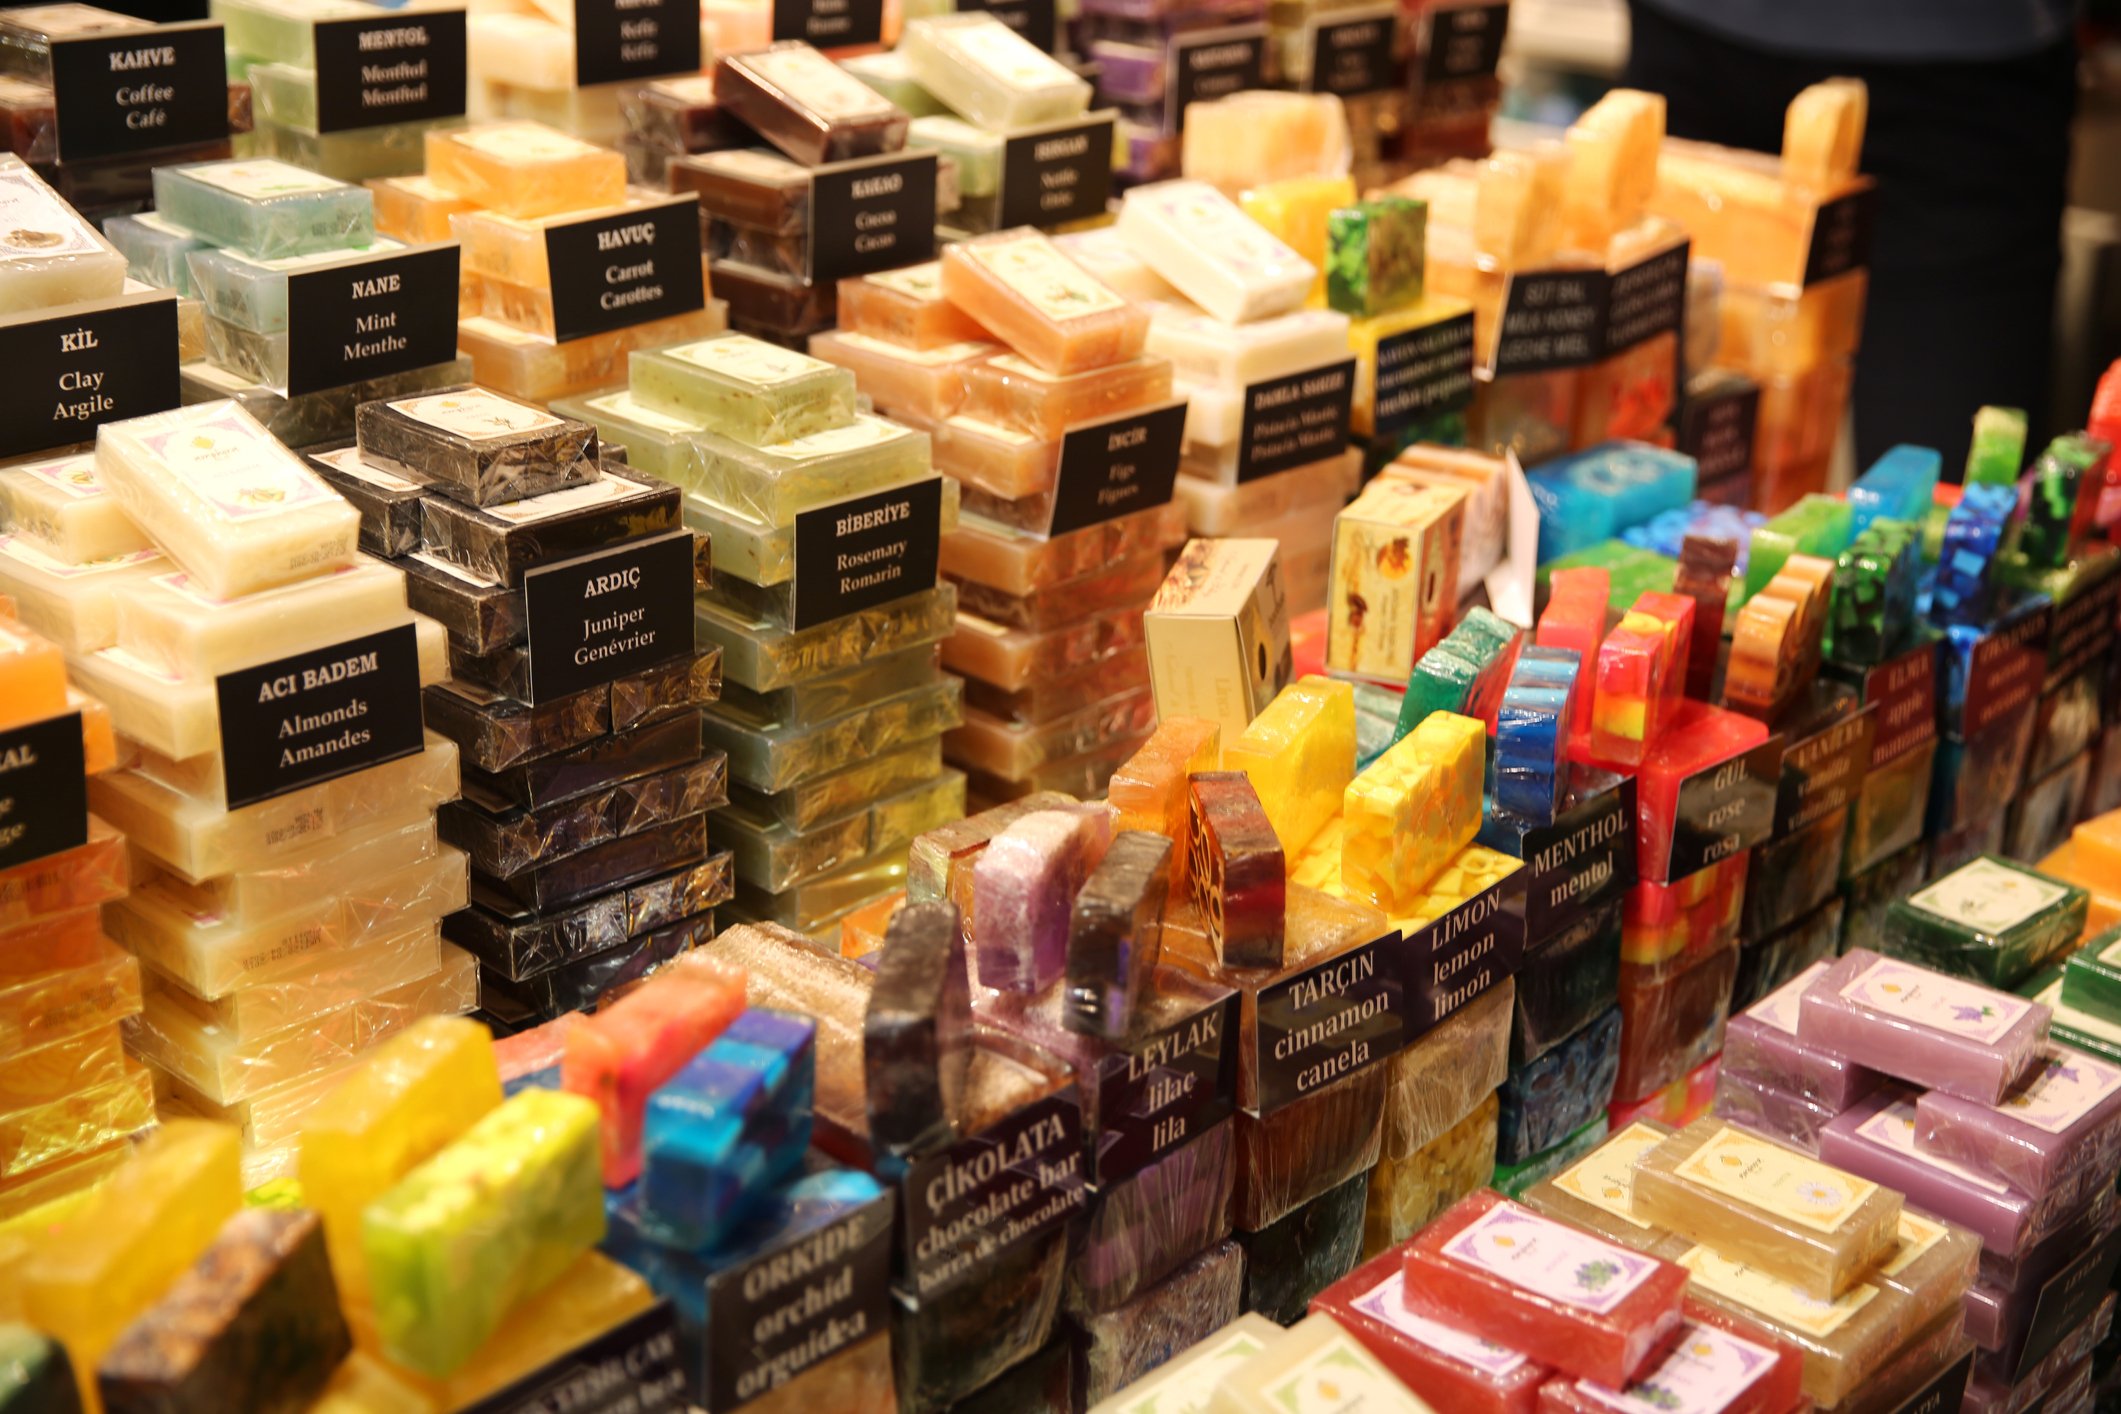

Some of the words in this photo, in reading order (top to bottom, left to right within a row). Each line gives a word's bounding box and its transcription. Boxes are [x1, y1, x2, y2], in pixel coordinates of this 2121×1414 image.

[358, 26, 430, 51] MENTOL
[109, 46, 176, 72] KAHVE
[361, 59, 428, 83] Menthol
[115, 83, 175, 106] Coffee
[361, 82, 428, 108] Menthol
[126, 107, 167, 130] Café
[598, 222, 656, 250] HAVUÇ
[352, 274, 401, 299] NANE
[605, 259, 654, 284] Carrot
[600, 284, 663, 310] Carottes
[61, 328, 99, 352] KİL
[356, 312, 397, 334] Mint
[344, 335, 407, 361] Menthe
[59, 371, 104, 391] Clay
[53, 395, 114, 420] Argile
[836, 502, 910, 537] BİBERİYE
[837, 540, 908, 571] Rosemary
[584, 566, 641, 598] ARDIÇ
[840, 564, 902, 594] Romarin
[583, 607, 645, 641] Juniper
[574, 630, 656, 666] Genévrier
[258, 674, 297, 703] ACI
[302, 651, 379, 690] BADEM
[278, 699, 368, 739] Almonds
[279, 728, 371, 768] Amandes
[1708, 797, 1745, 829] rose
[1535, 808, 1628, 879] MENTHOL
[1703, 832, 1740, 865] rosa
[1551, 849, 1613, 908] mentol
[1431, 888, 1500, 952] LİMON
[1433, 931, 1495, 986] lemon
[1288, 950, 1374, 1011] TARÇIN
[1434, 965, 1491, 1021] limón
[1274, 990, 1390, 1060] cinnamon
[1128, 1011, 1217, 1083] LEYLAK
[1296, 1039, 1370, 1092] canela
[1149, 1071, 1195, 1114] lilac
[1152, 1115, 1186, 1152] lila
[925, 1113, 1065, 1217] ÇİKOLATA
[916, 1179, 1034, 1260] chocolate
[1038, 1151, 1081, 1190] bar
[974, 1234, 998, 1260] de
[1000, 1185, 1085, 1245] chocolate
[753, 1265, 853, 1342] orchid
